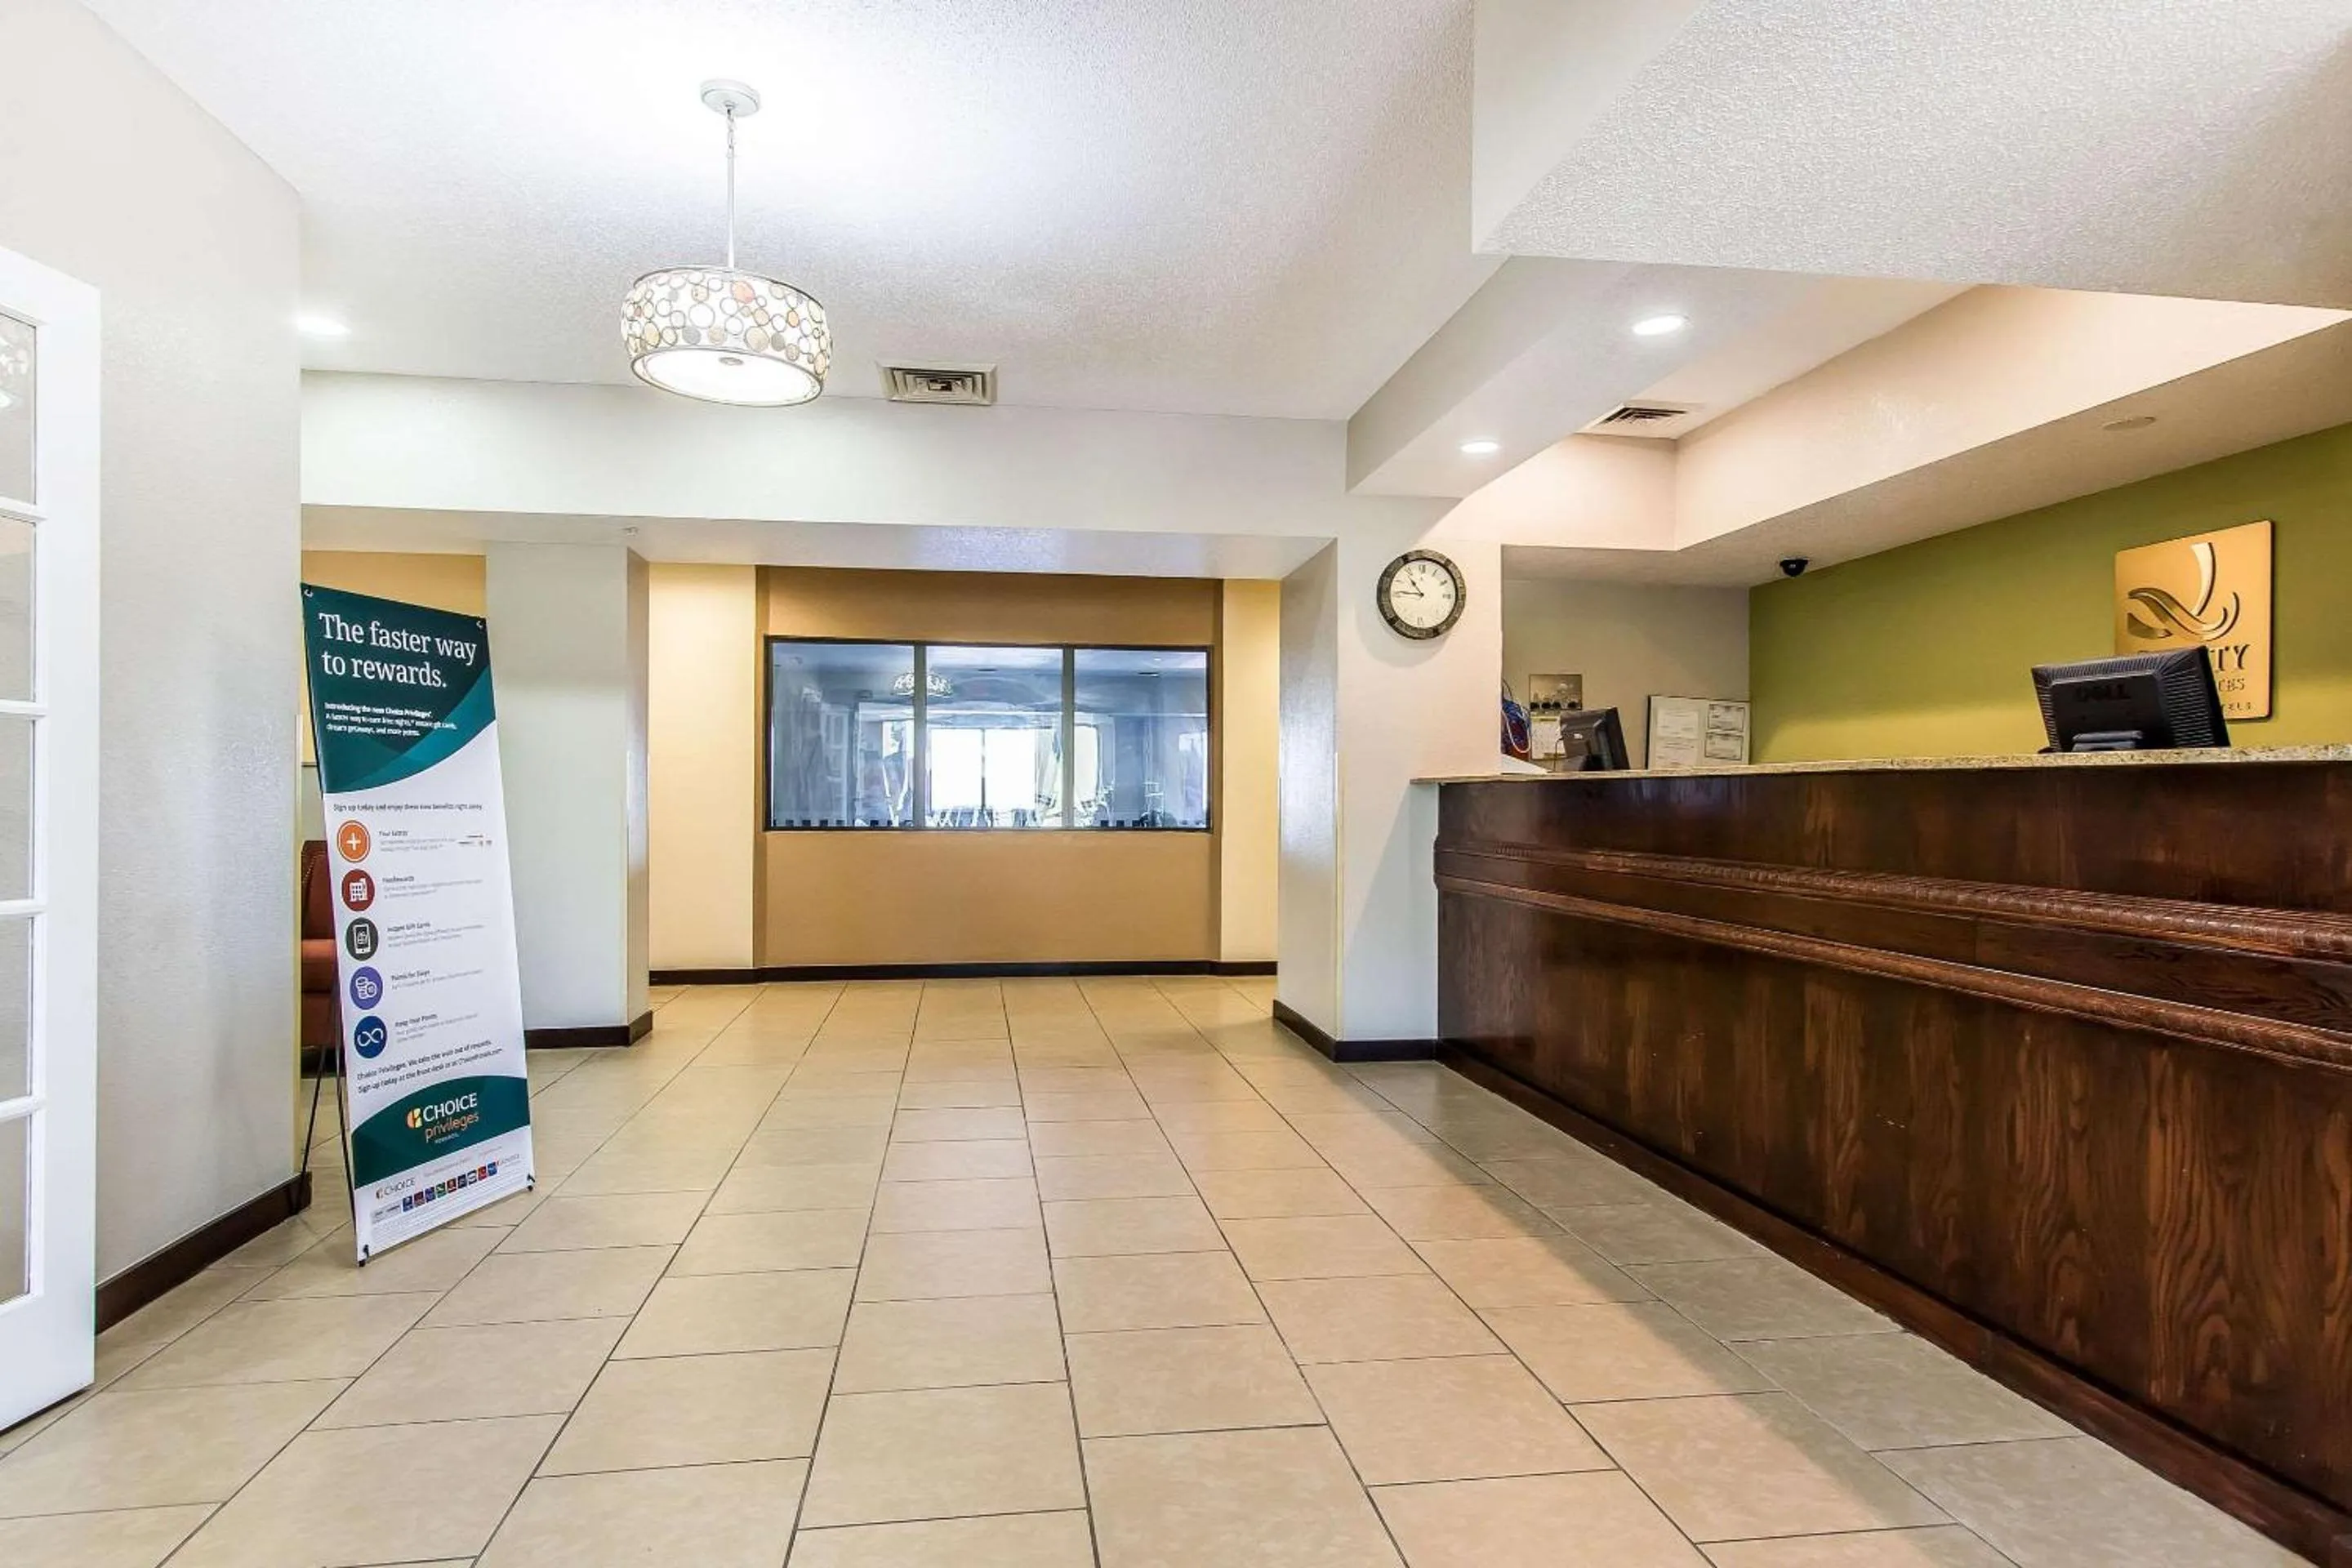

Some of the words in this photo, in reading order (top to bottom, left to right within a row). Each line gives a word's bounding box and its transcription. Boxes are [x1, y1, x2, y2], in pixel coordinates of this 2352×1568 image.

[318, 612, 364, 644] The
[370, 621, 431, 653] faster
[435, 636, 477, 666] way
[322, 651, 345, 675] to
[351, 658, 447, 688] rewards.
[423, 1092, 478, 1122] CHOICE
[425, 1111, 479, 1144] privileges
